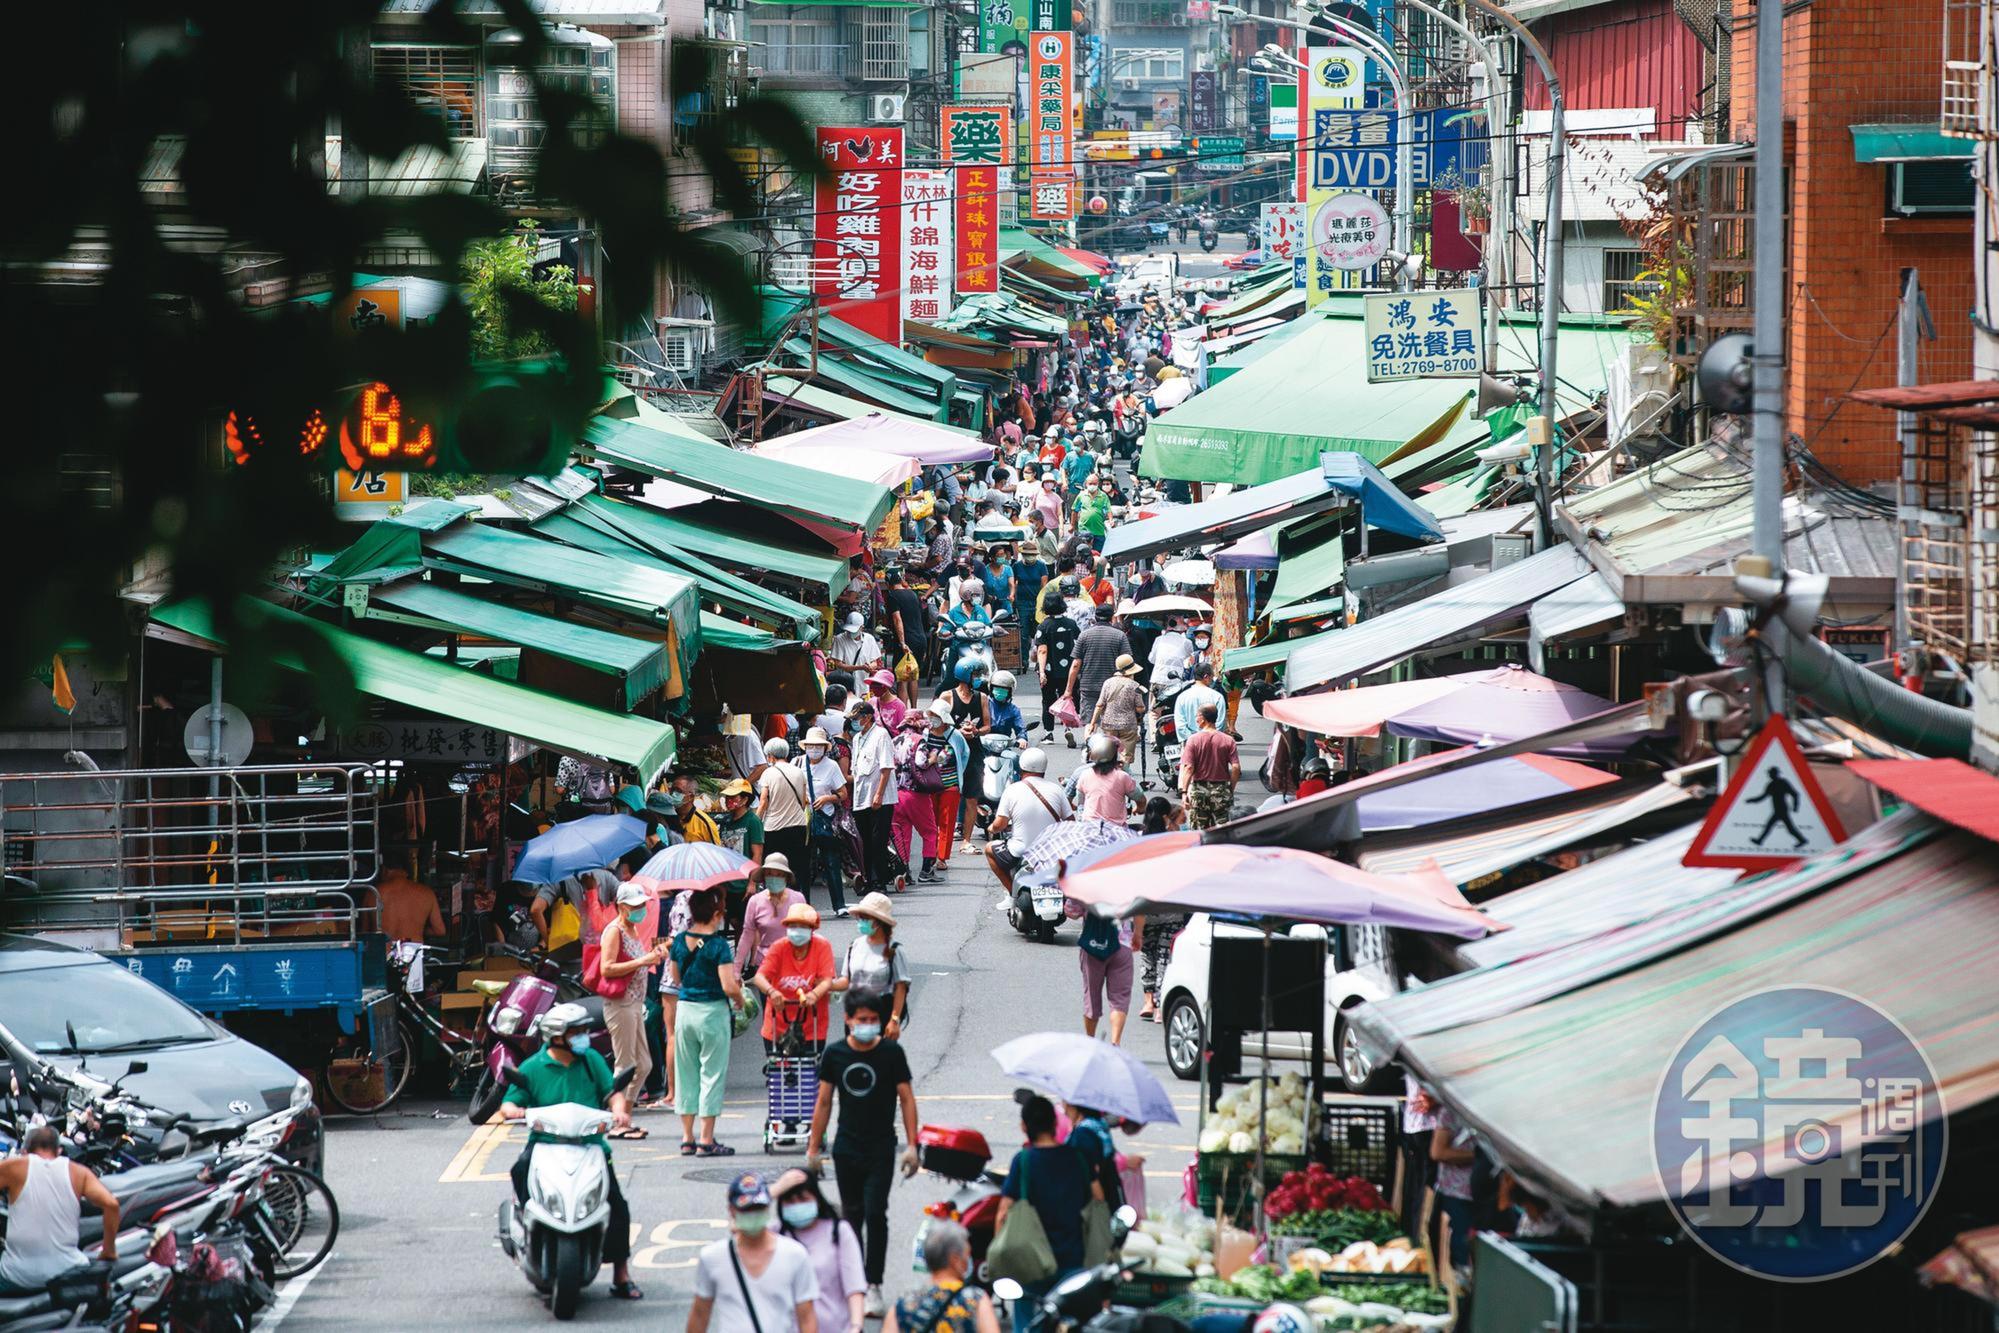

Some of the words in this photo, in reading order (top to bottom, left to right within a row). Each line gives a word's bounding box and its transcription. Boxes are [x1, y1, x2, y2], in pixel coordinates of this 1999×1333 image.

[949, 110, 1002, 164] 藥
[1319, 113, 1391, 147] 漫畫
[821, 140, 842, 163] 阿
[876, 139, 897, 165] 美
[1317, 152, 1391, 186] DVD
[836, 172, 881, 300] 好吃雞肉便當
[1272, 216, 1296, 260] 小吃
[909, 203, 939, 319] 什錦海鮮麵
[1371, 329, 1476, 361] 免洗餐具
[1372, 358, 1477, 376] TEL:2769-8700
